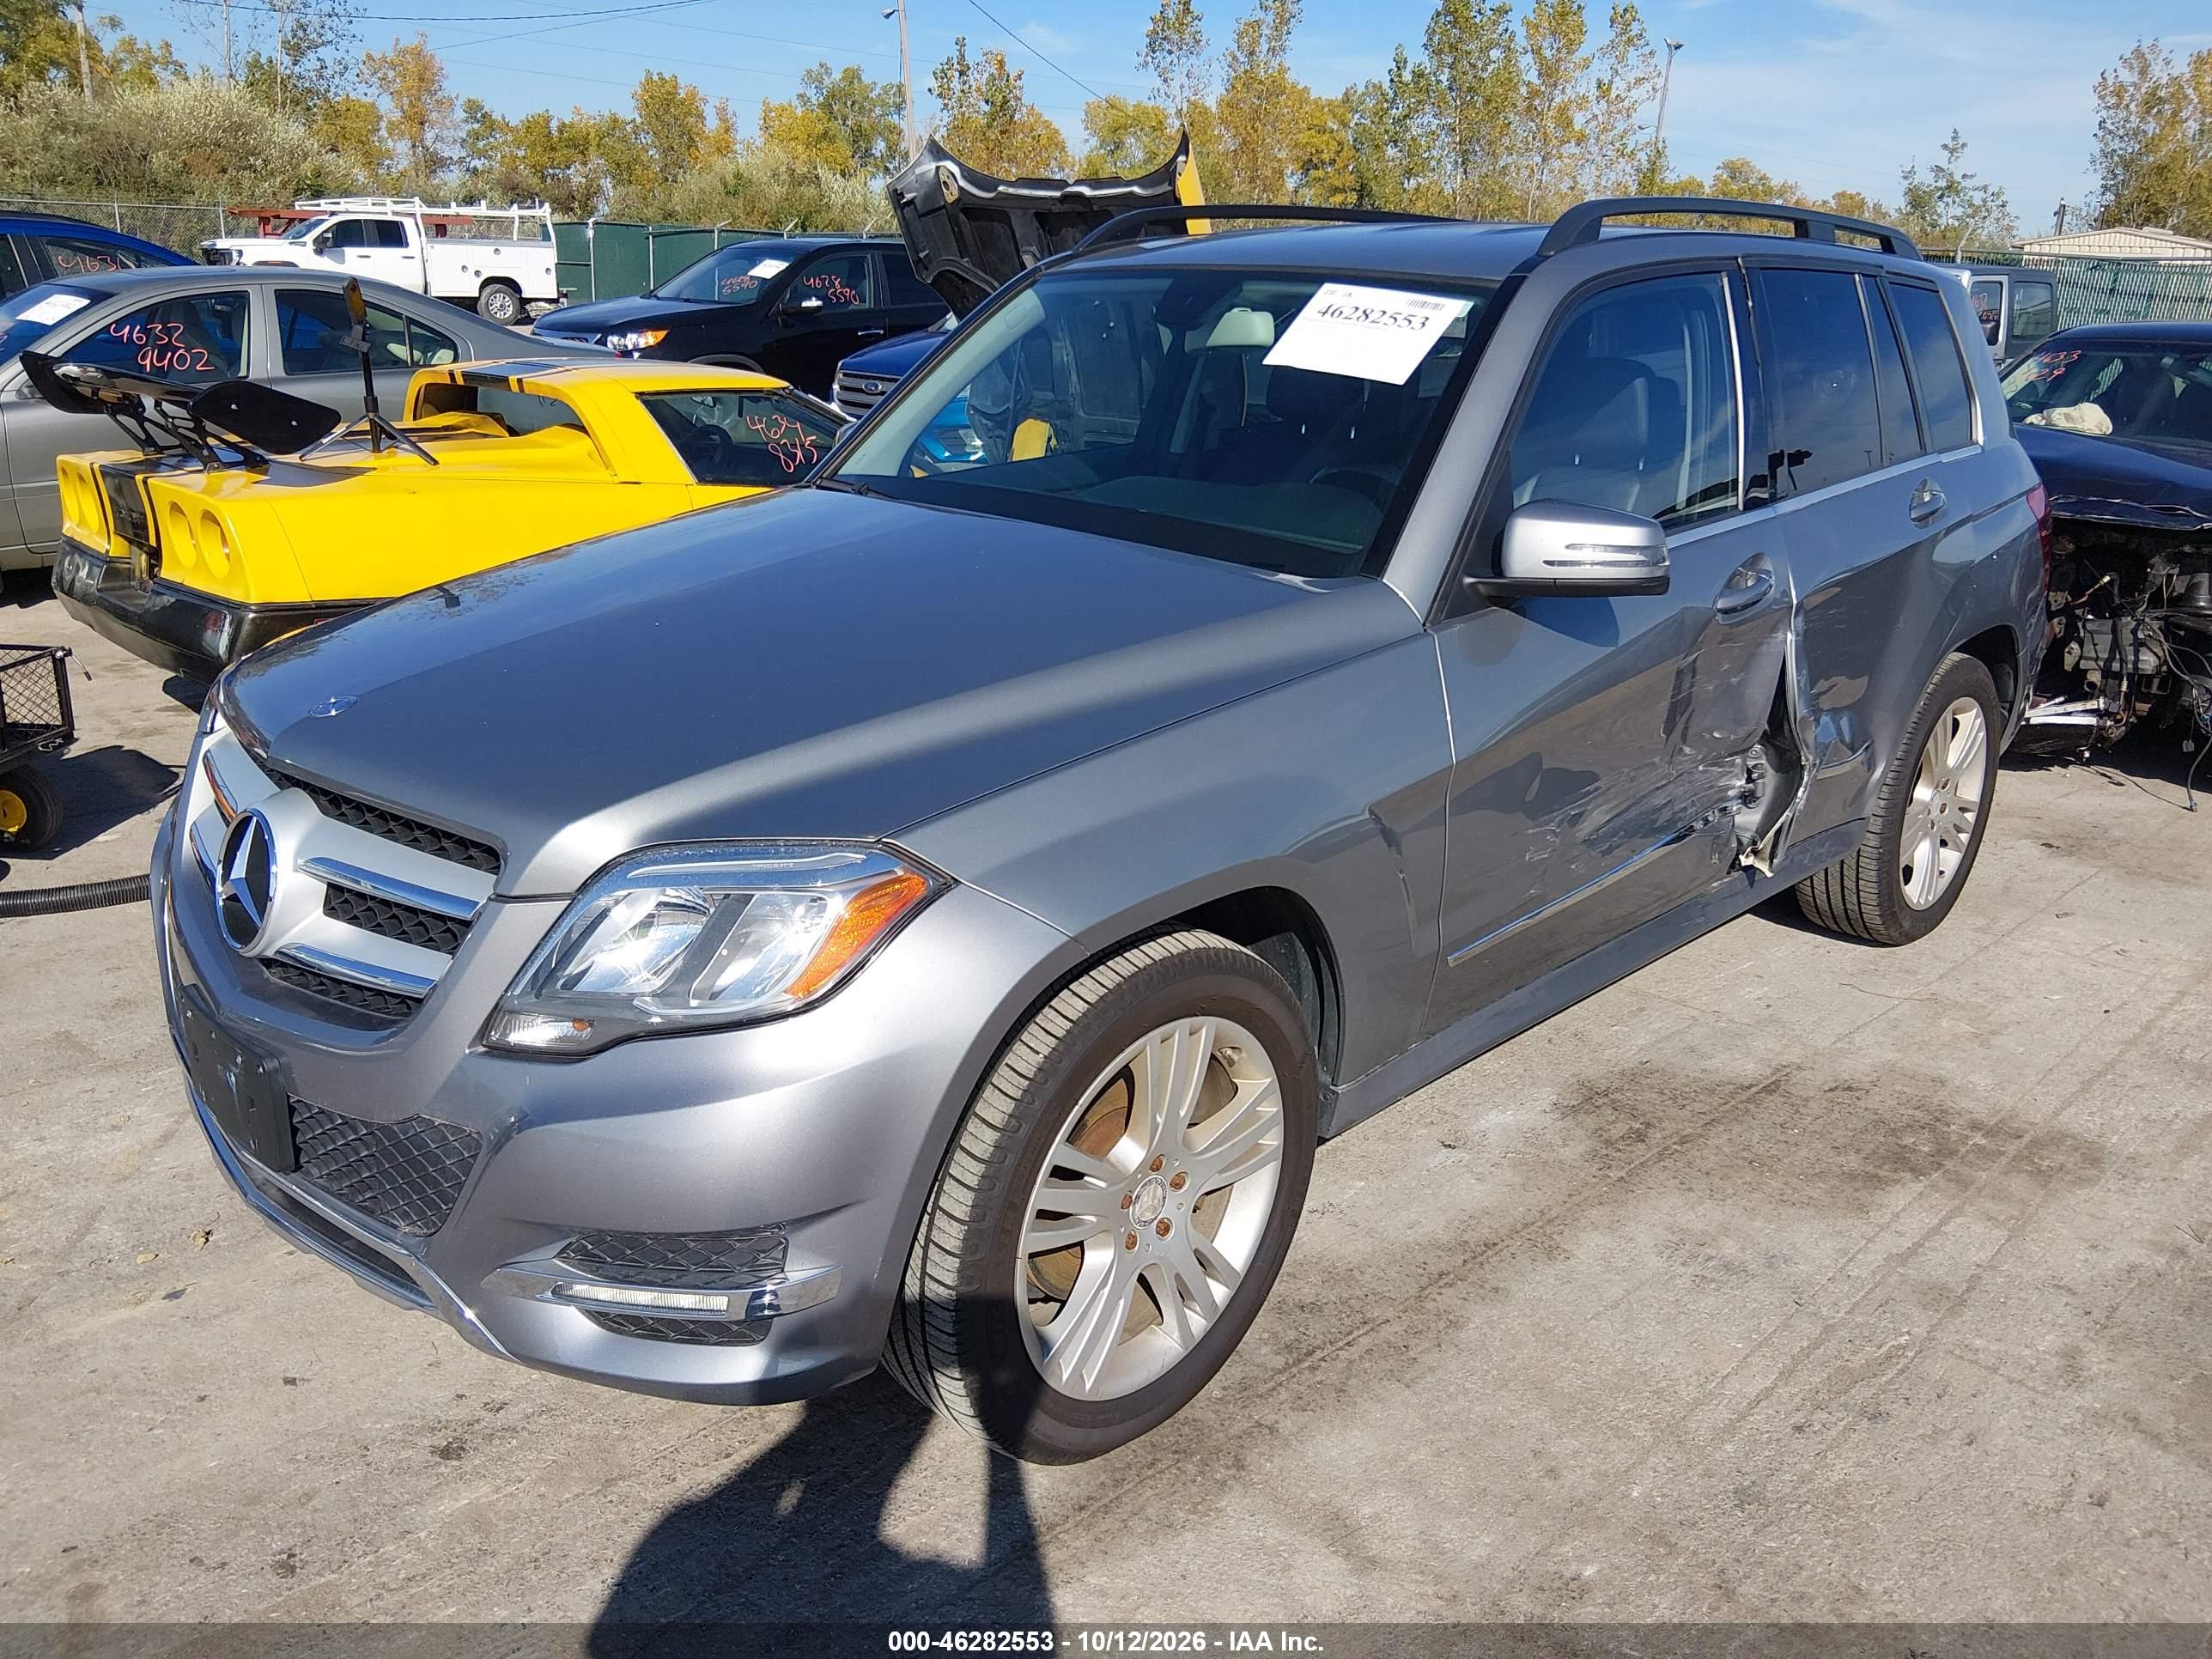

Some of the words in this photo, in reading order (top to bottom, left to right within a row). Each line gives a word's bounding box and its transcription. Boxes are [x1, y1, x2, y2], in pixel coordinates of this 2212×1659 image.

[828, 288, 860, 305] 5590
[1317, 303, 1430, 331] 46282553
[110, 323, 185, 348] 4632
[137, 346, 216, 373] 9402
